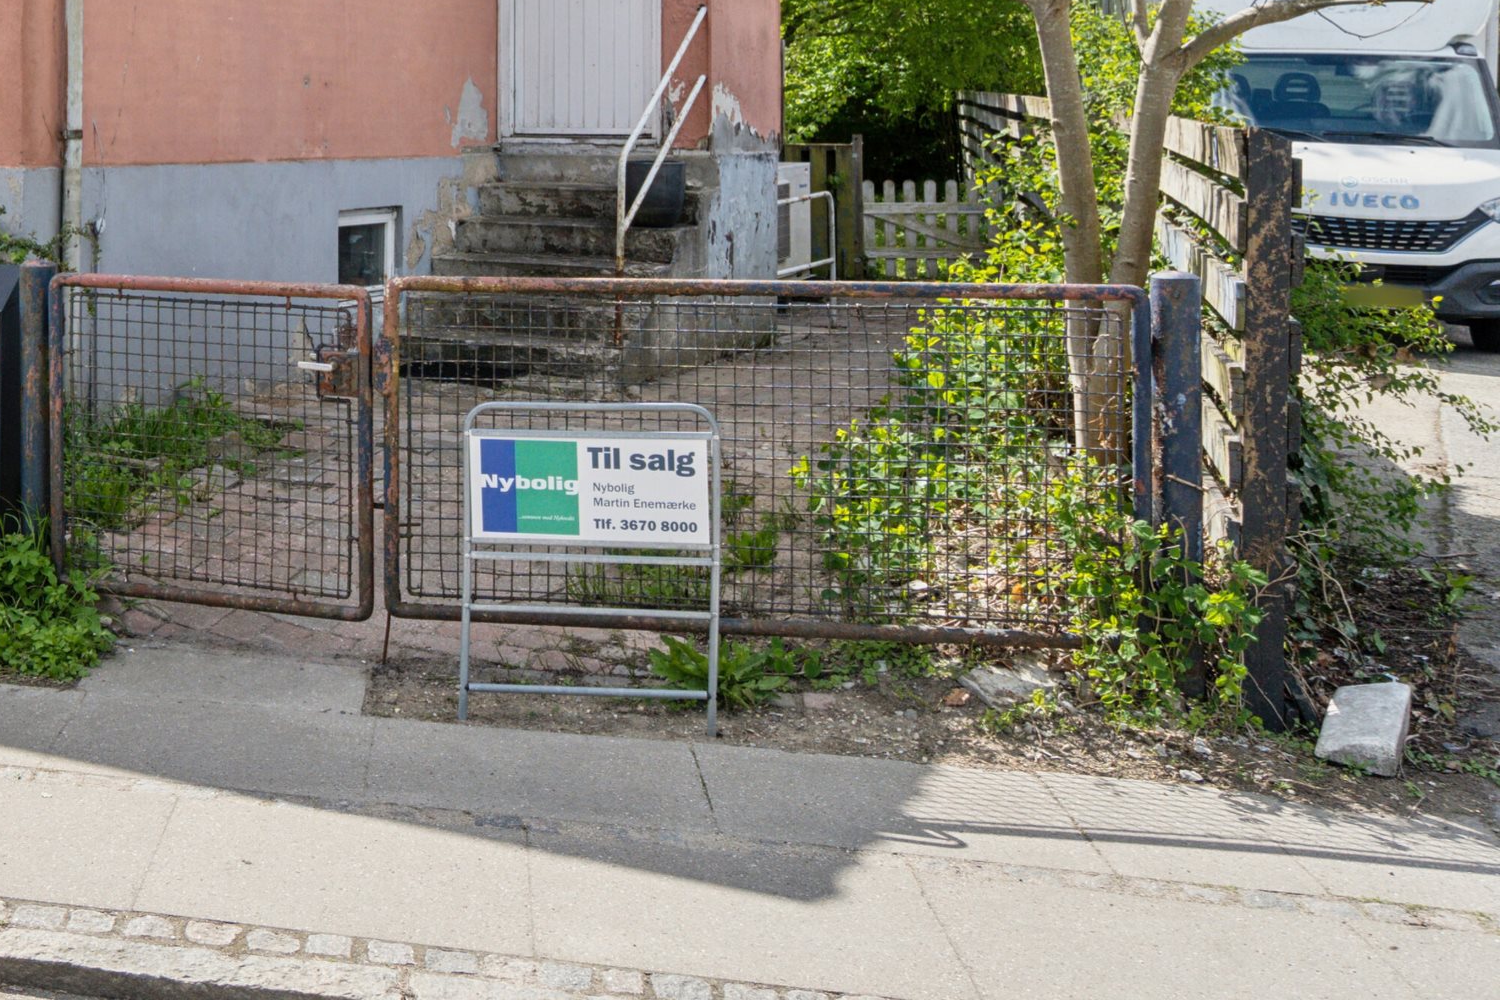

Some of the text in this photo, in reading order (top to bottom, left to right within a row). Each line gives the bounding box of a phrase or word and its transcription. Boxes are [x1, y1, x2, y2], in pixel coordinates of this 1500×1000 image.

[1330, 191, 1420, 210] IVECO
[587, 446, 696, 478] Til salg
[480, 473, 579, 496] Nybolig
[592, 482, 635, 496] Nybolig
[593, 497, 697, 511] Martin Enemærke
[593, 518, 698, 533] Tlf. 3670 8000
